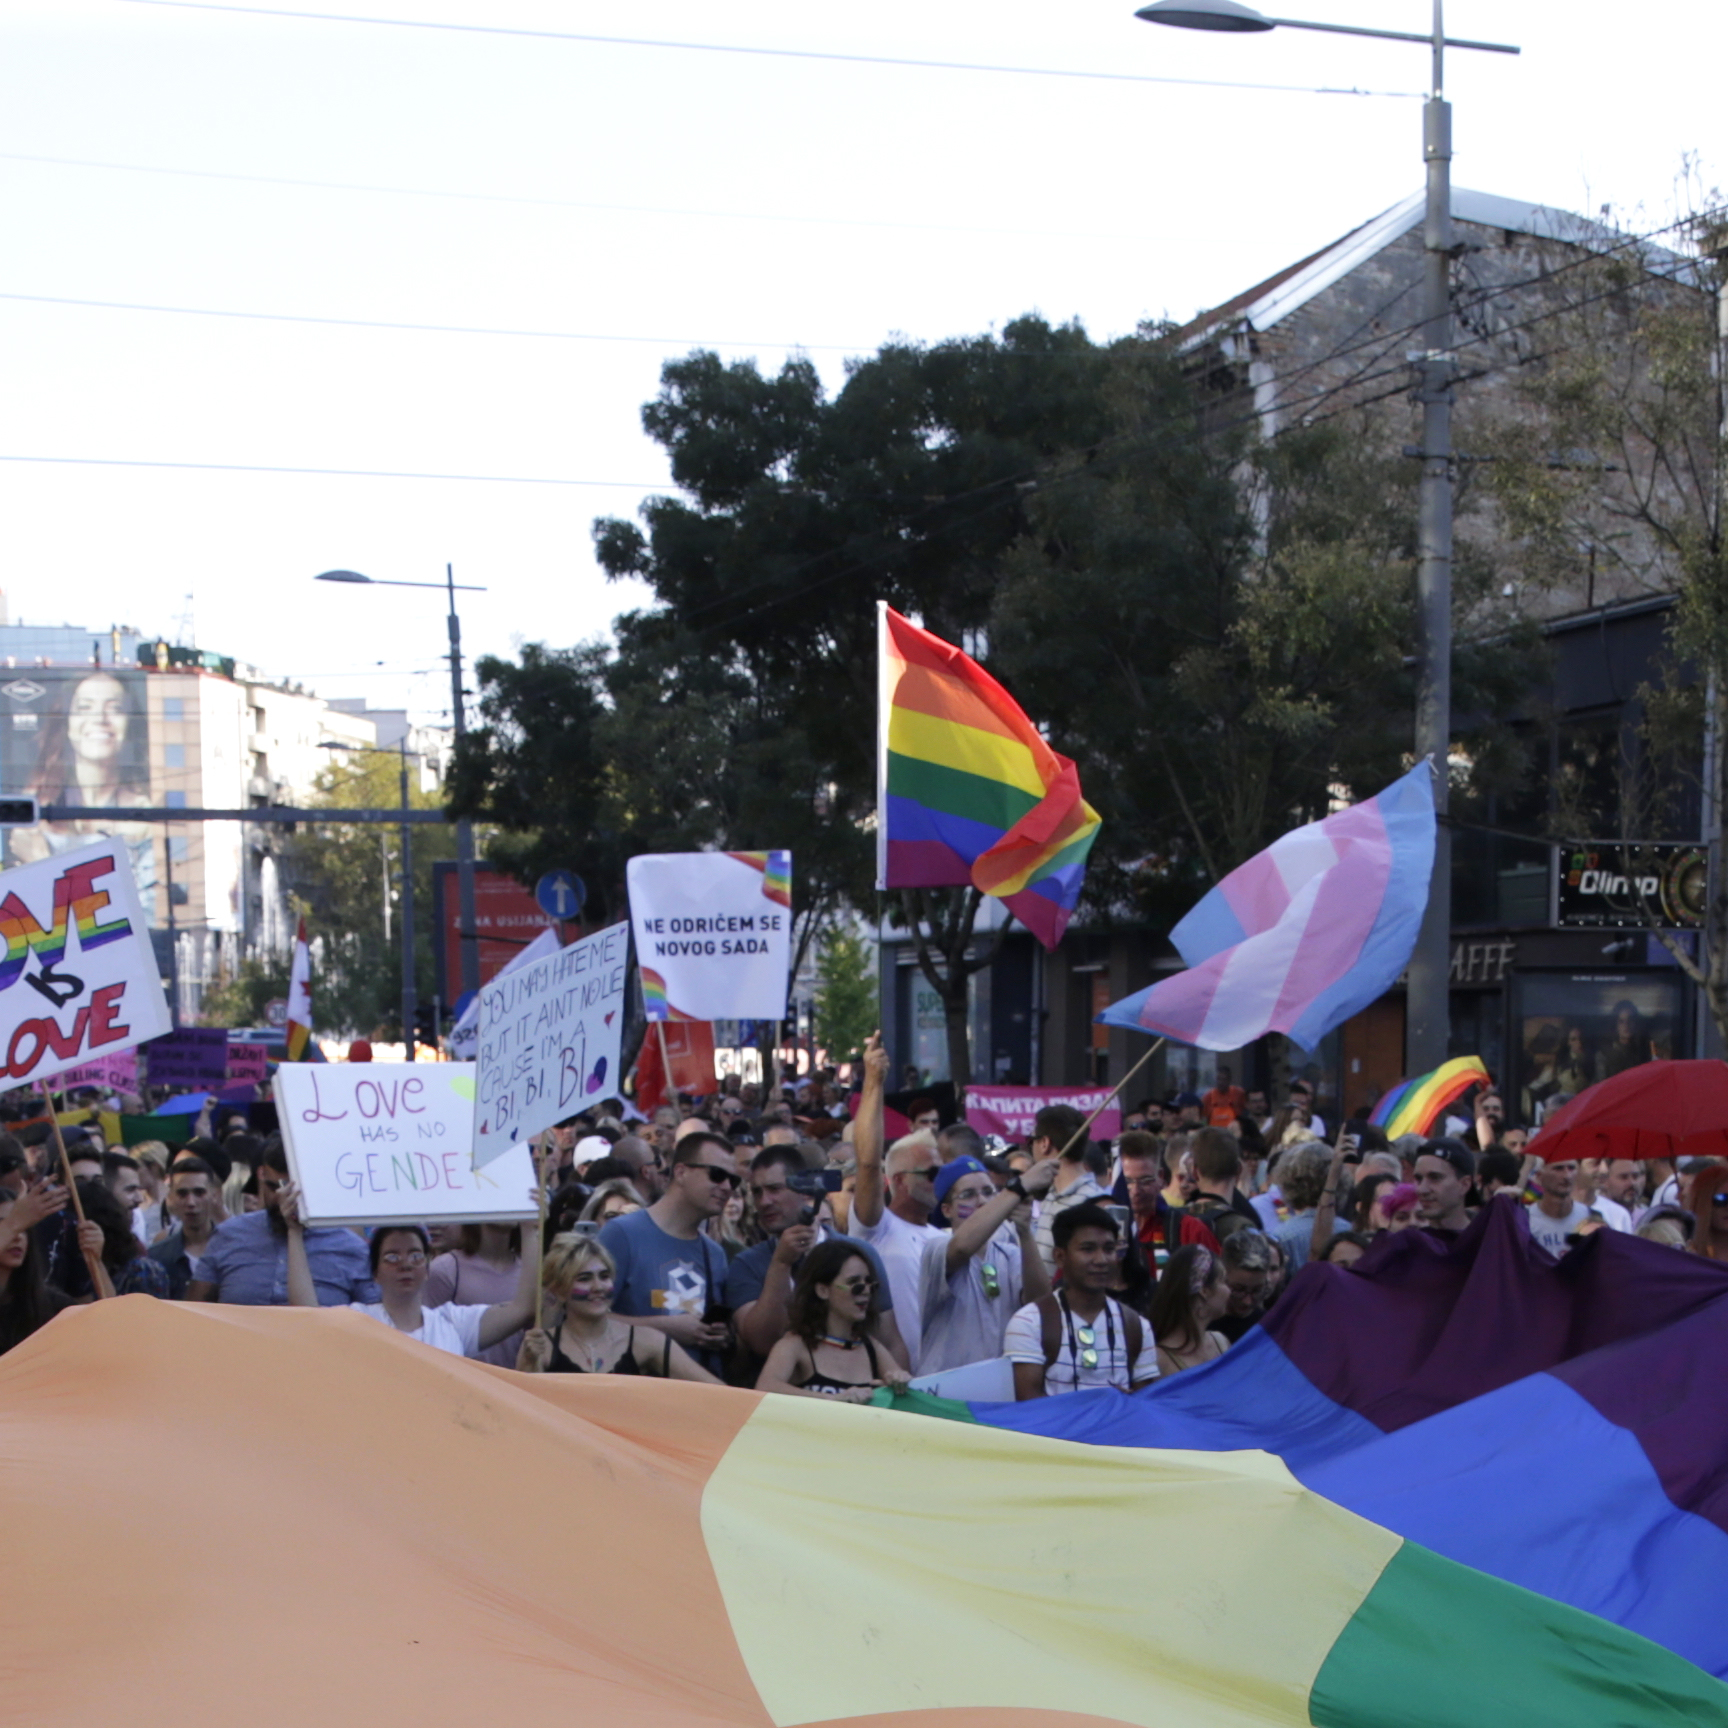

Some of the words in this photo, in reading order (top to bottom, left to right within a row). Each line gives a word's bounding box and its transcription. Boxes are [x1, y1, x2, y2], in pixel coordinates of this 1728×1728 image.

[644, 918, 665, 934] NE
[670, 912, 754, 933] ODRIČEM
[759, 915, 781, 931] SE
[656, 941, 716, 957] NOVOG
[721, 939, 769, 955] SADA
[24, 964, 85, 1009] IS
[481, 978, 514, 1037] YOU
[521, 964, 548, 999] MAY
[589, 933, 617, 968] ME
[481, 1027, 511, 1073] BUT
[517, 1012, 532, 1045] IT
[534, 988, 578, 1035] AINT
[480, 1045, 534, 1104] CAUSE
[570, 1020, 585, 1044] A
[558, 1037, 586, 1109] BI
[359, 1125, 399, 1142] HAS
[418, 1121, 446, 1138] NO
